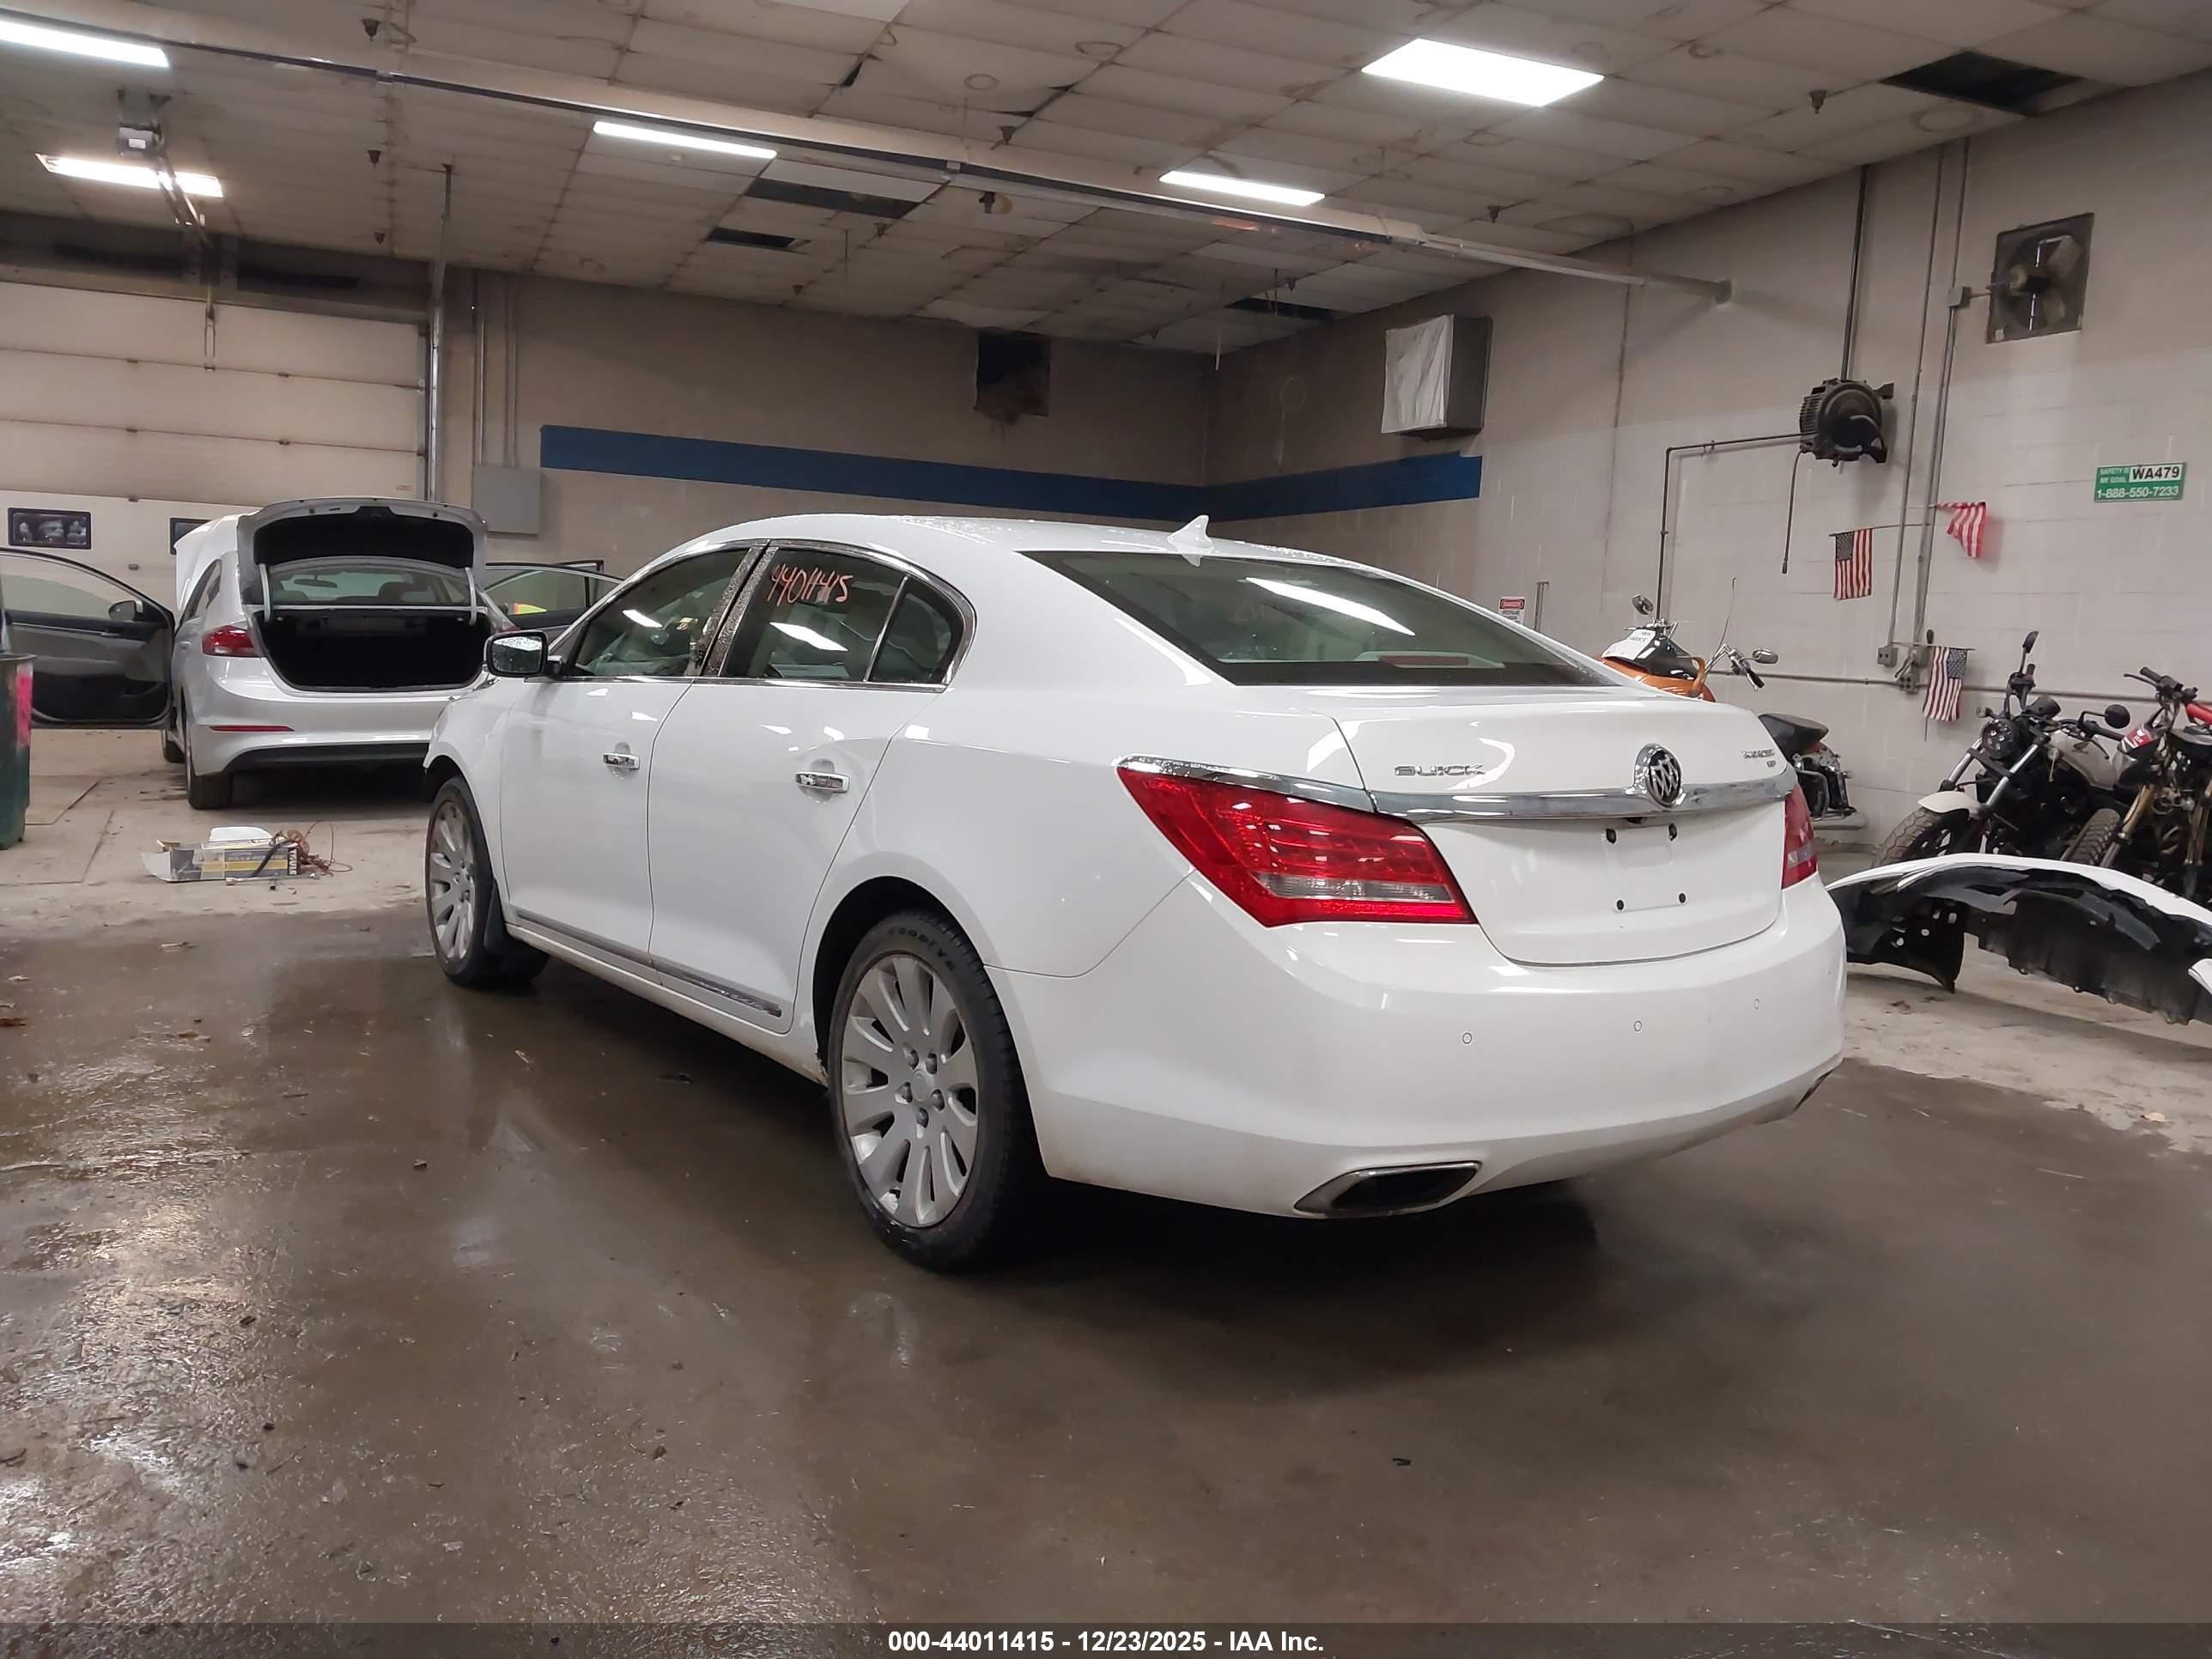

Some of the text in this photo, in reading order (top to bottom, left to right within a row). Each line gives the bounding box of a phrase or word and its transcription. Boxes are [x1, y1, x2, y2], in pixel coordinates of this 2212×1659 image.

[2132, 466, 2180, 480] WA479
[2097, 486, 2179, 499] 1-888-550-7233
[1394, 764, 1486, 776] BUICK
